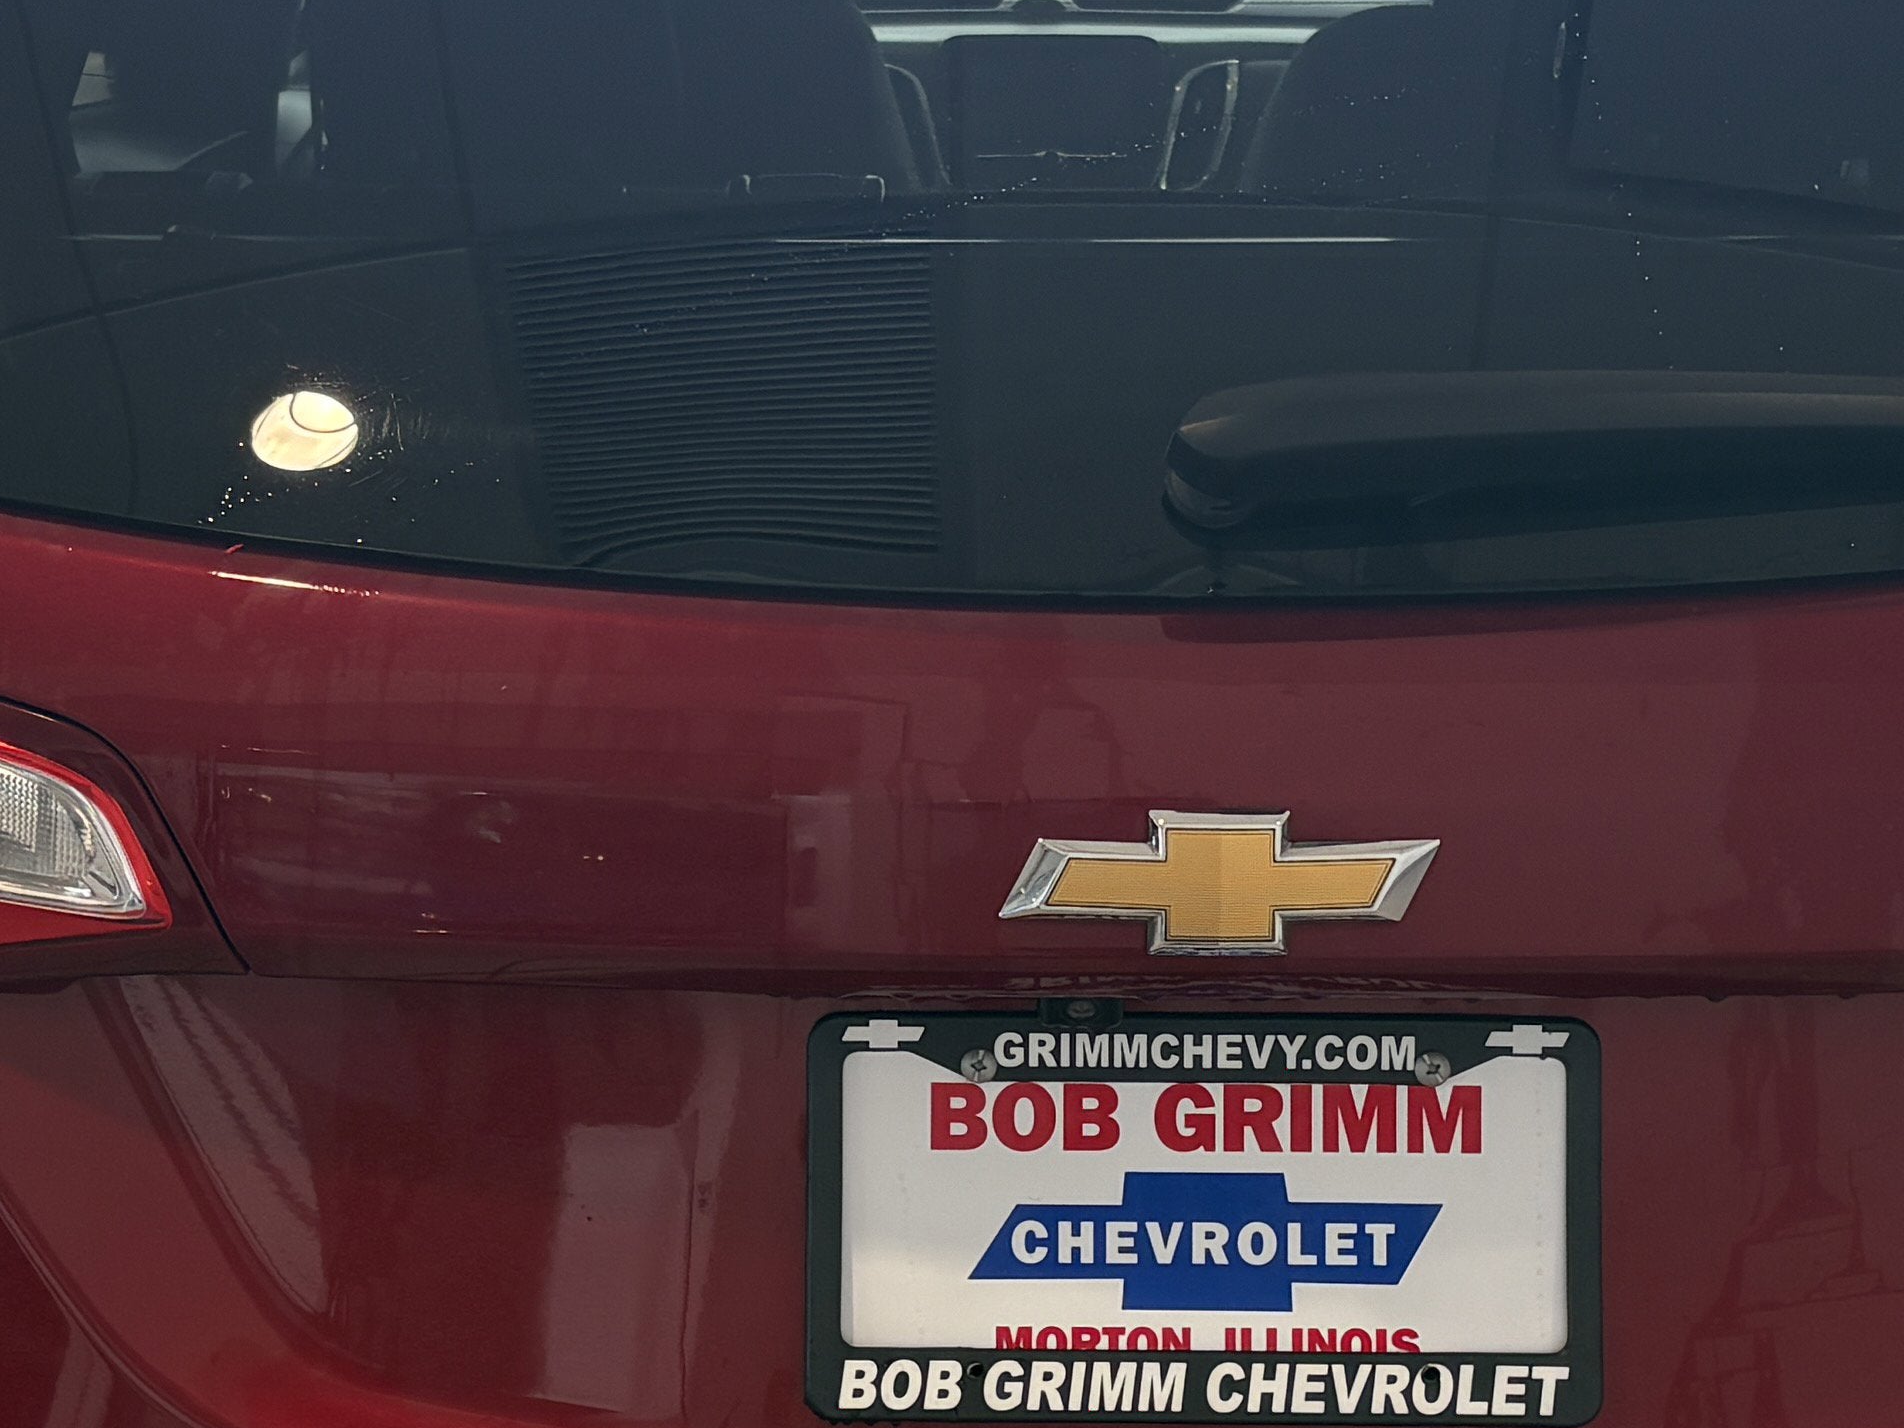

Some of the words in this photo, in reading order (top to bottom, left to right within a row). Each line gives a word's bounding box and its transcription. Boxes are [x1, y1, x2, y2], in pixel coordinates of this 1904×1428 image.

[992, 1031, 1418, 1072] GRIMMCHEVY.COM
[930, 1082, 1121, 1153] BOB
[1154, 1083, 1484, 1155] GRIMM
[1010, 1220, 1397, 1268] CHEVROLET
[838, 1359, 963, 1413] BOB
[982, 1361, 1185, 1414] GRIMM
[1206, 1363, 1570, 1418] CHEVROLET
